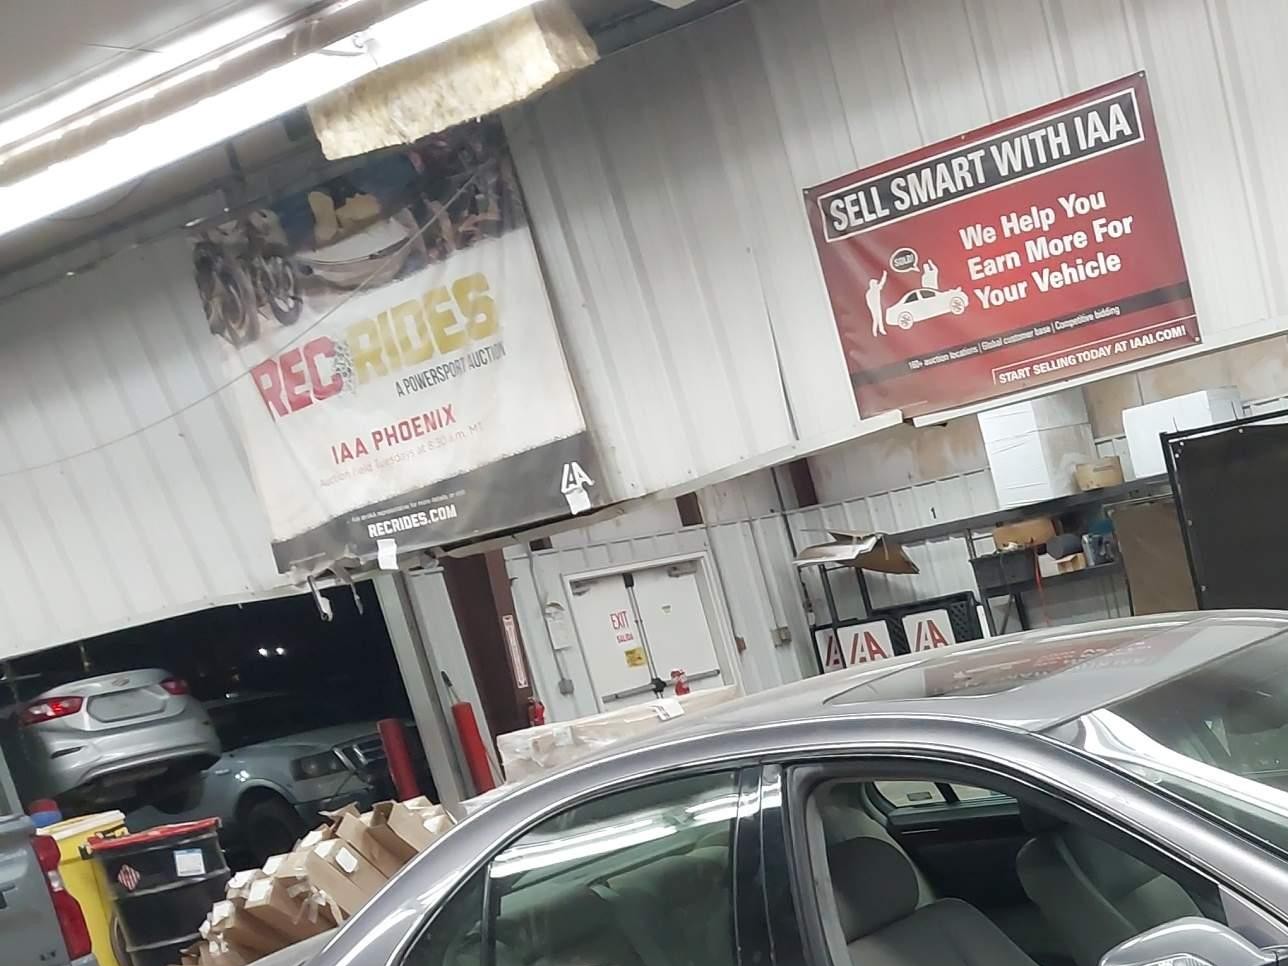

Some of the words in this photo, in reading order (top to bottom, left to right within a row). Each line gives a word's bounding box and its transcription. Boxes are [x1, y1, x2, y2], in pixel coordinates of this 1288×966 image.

[829, 186, 891, 232] SELL
[890, 150, 986, 212] SMART
[990, 122, 1071, 177] WITH
[1074, 103, 1133, 151] IAA
[959, 224, 997, 250] We
[1000, 206, 1056, 238] Help
[1057, 191, 1107, 219] You
[967, 251, 1021, 281] Earn
[1024, 231, 1088, 264] More
[1091, 215, 1133, 243] For
[973, 281, 1028, 309] Your
[1032, 252, 1121, 292] Vehicle
[250, 335, 344, 417] REC
[345, 272, 498, 385] RIDES
[999, 367, 1031, 384] START
[1033, 355, 1077, 376] SELLING
[1077, 346, 1112, 363] TODAY
[1114, 340, 1129, 354] AT
[1130, 325, 1186, 350] IAAI.COM!
[1003, 330, 1034, 345] customer
[1055, 313, 1094, 331] Competitive
[1094, 306, 1120, 320] bidding
[395, 381, 406, 398] A
[403, 358, 467, 396] POWERSPORT
[467, 341, 507, 370] AUCTION
[331, 437, 369, 465] IAA
[371, 403, 457, 450] PHOENIX
[367, 504, 457, 538] RECRIDES.COM
[930, 506, 937, 519] 1
[609, 610, 630, 630] EXIT
